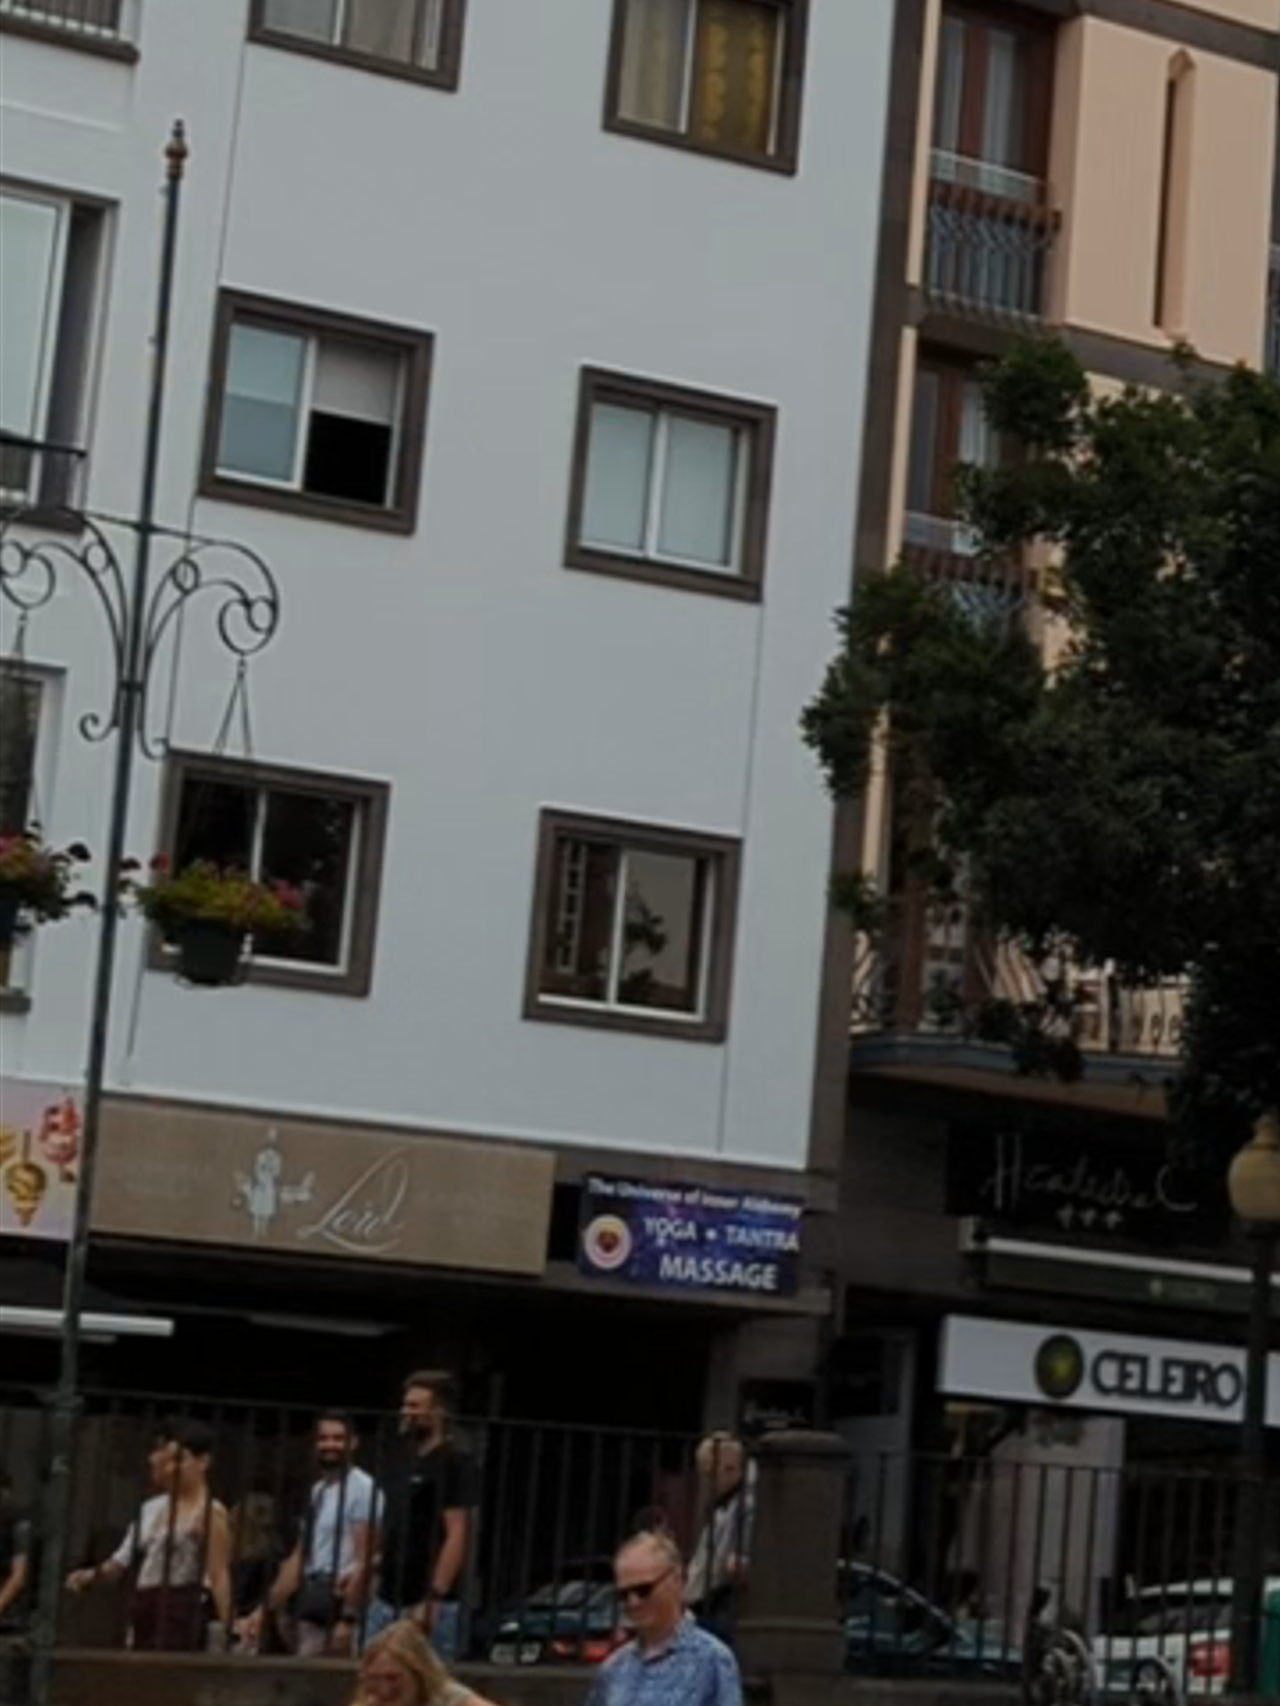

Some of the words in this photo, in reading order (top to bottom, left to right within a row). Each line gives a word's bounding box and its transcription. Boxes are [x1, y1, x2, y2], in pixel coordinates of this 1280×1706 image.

[642, 1216, 697, 1242] YOGA
[725, 1223, 800, 1252] TANTRA
[659, 1253, 779, 1290] MASSAGE
[1091, 1349, 1243, 1408] CELEIRO
